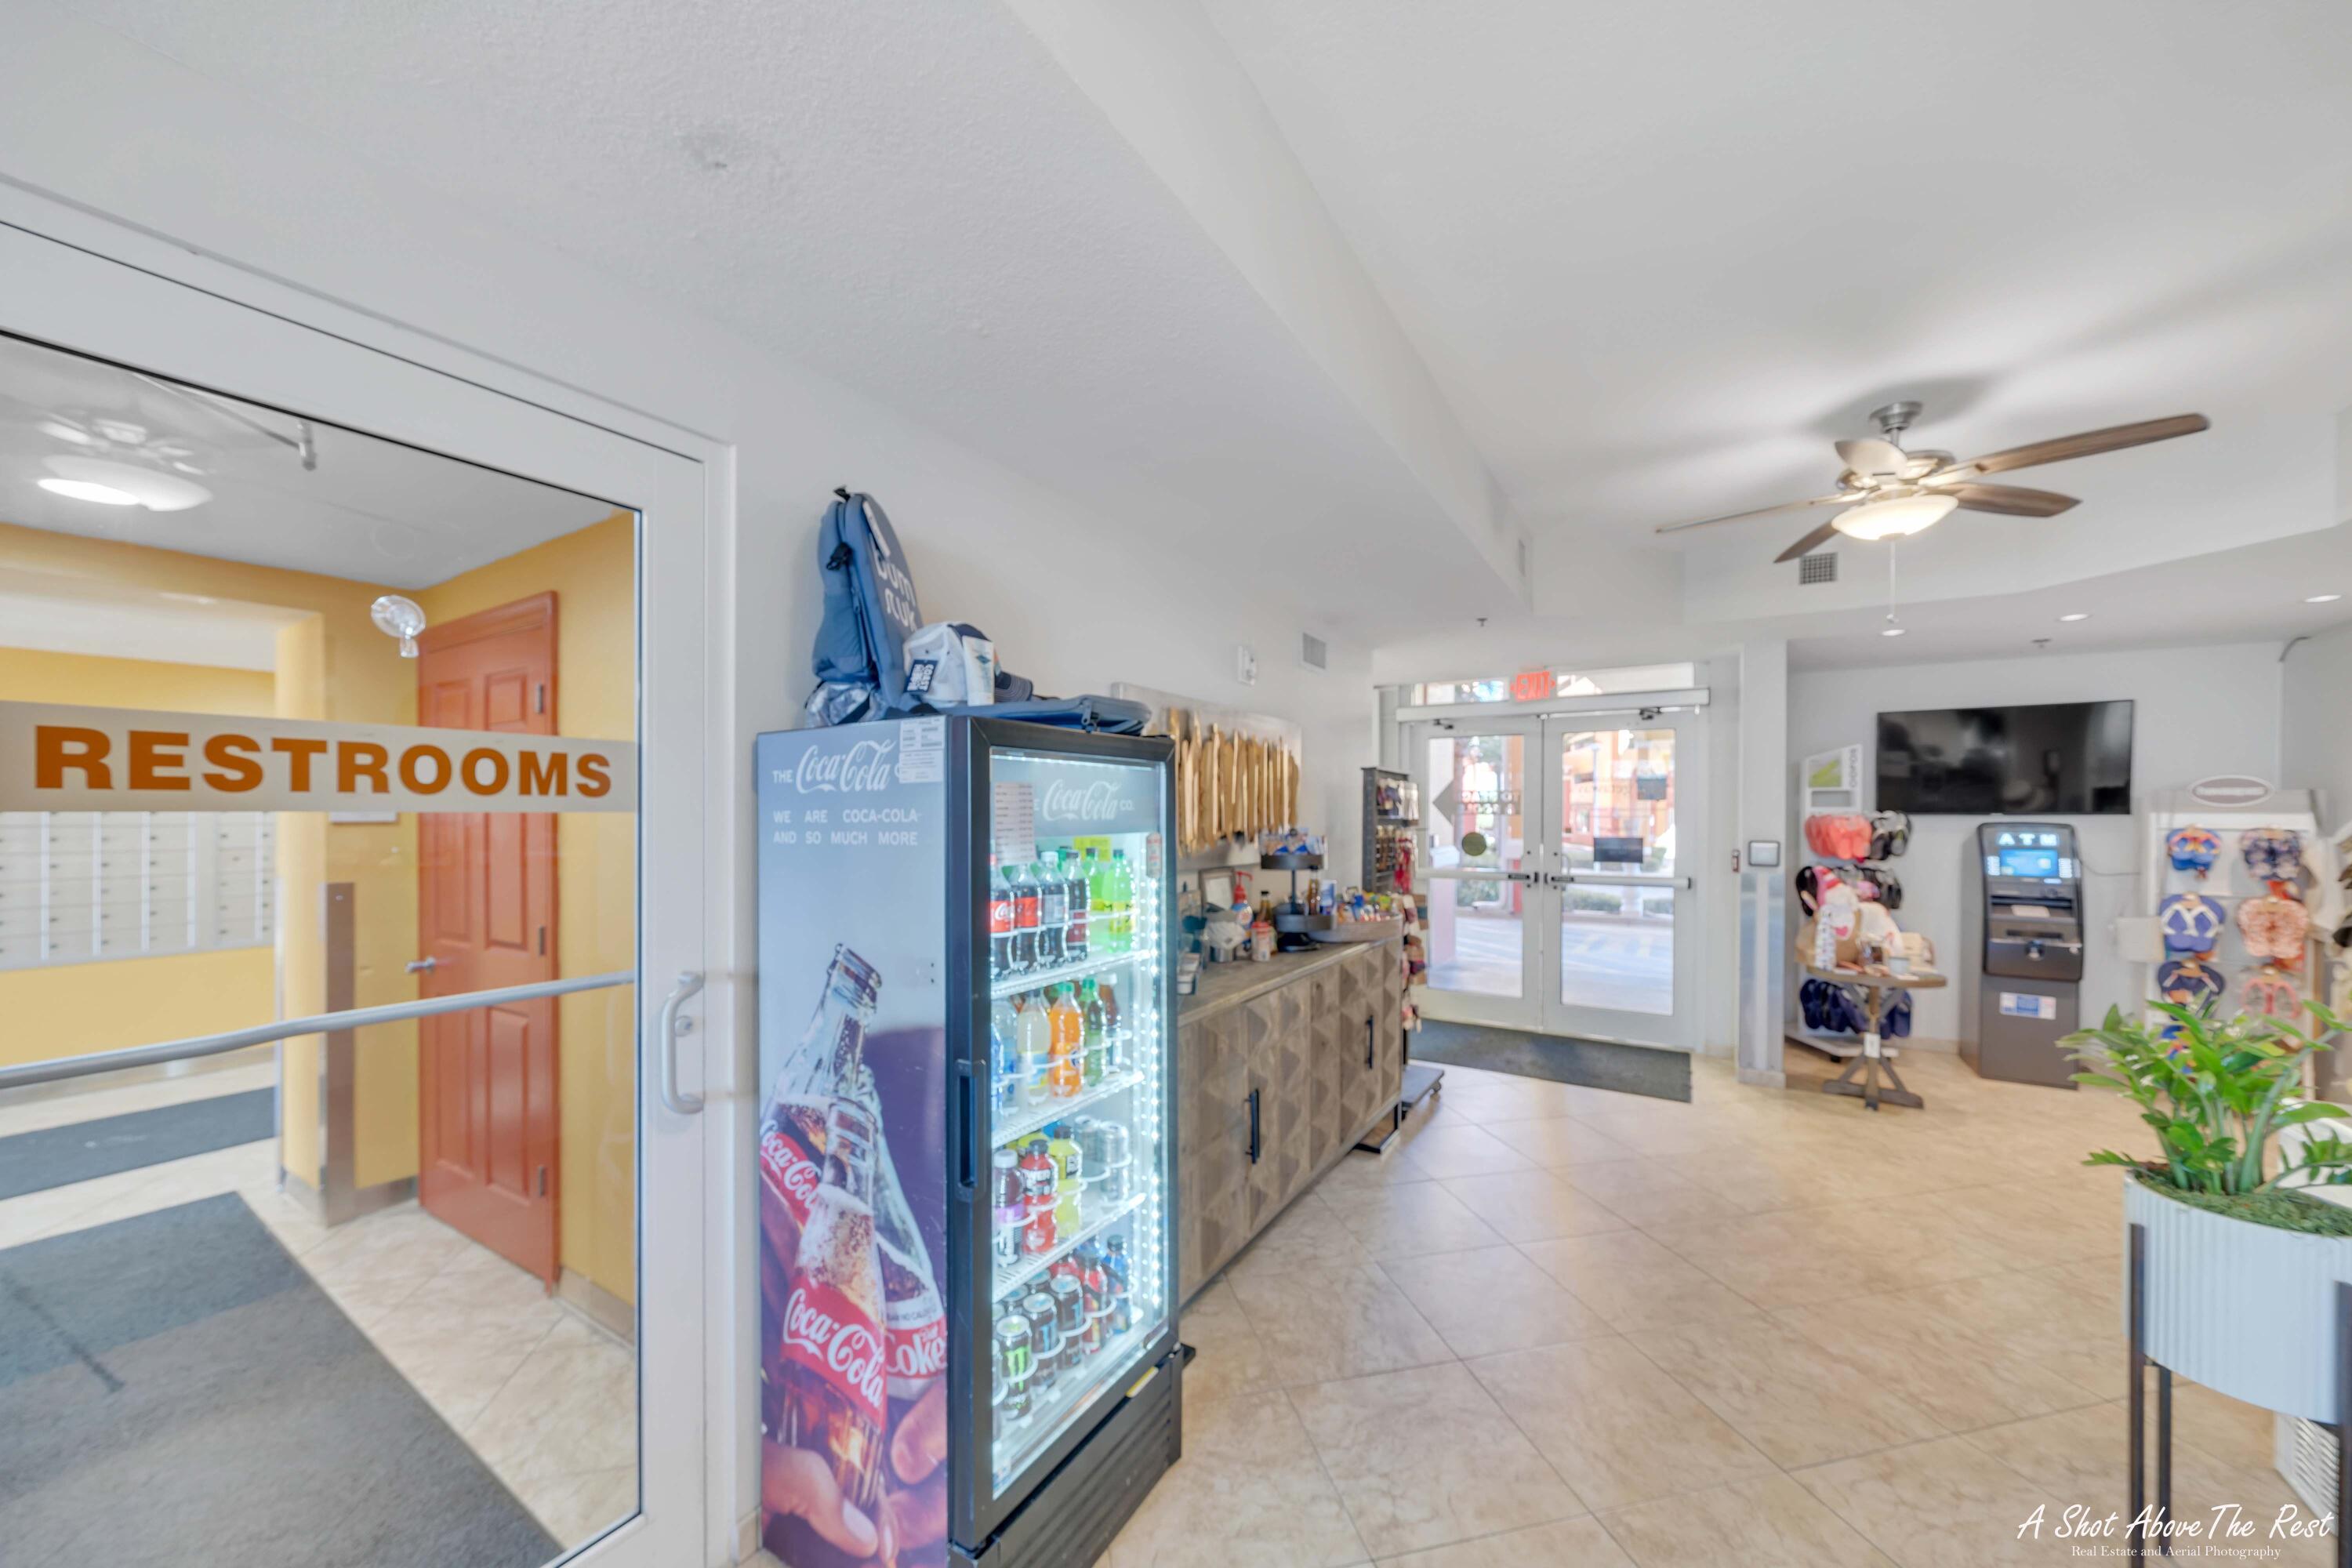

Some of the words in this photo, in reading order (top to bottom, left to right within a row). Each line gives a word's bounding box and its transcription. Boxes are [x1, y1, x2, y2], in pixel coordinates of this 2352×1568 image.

[1516, 671, 1550, 701] EXIT
[35, 725, 612, 797] RESTROOMS
[772, 769, 793, 783] THE
[796, 739, 896, 794] Coca-Cola
[773, 811, 791, 823] WE
[804, 810, 829, 823] ARE
[843, 809, 918, 823] COCA-COLA
[1043, 779, 1121, 822] Coca-Cola
[773, 831, 797, 844] AND
[805, 831, 822, 844] SO
[830, 832, 868, 845] MUCH
[878, 832, 918, 846] MORE
[1998, 833, 2058, 847] ATM
[759, 1120, 823, 1210] Coca-Co
[783, 1288, 886, 1408] Coca-Cola
